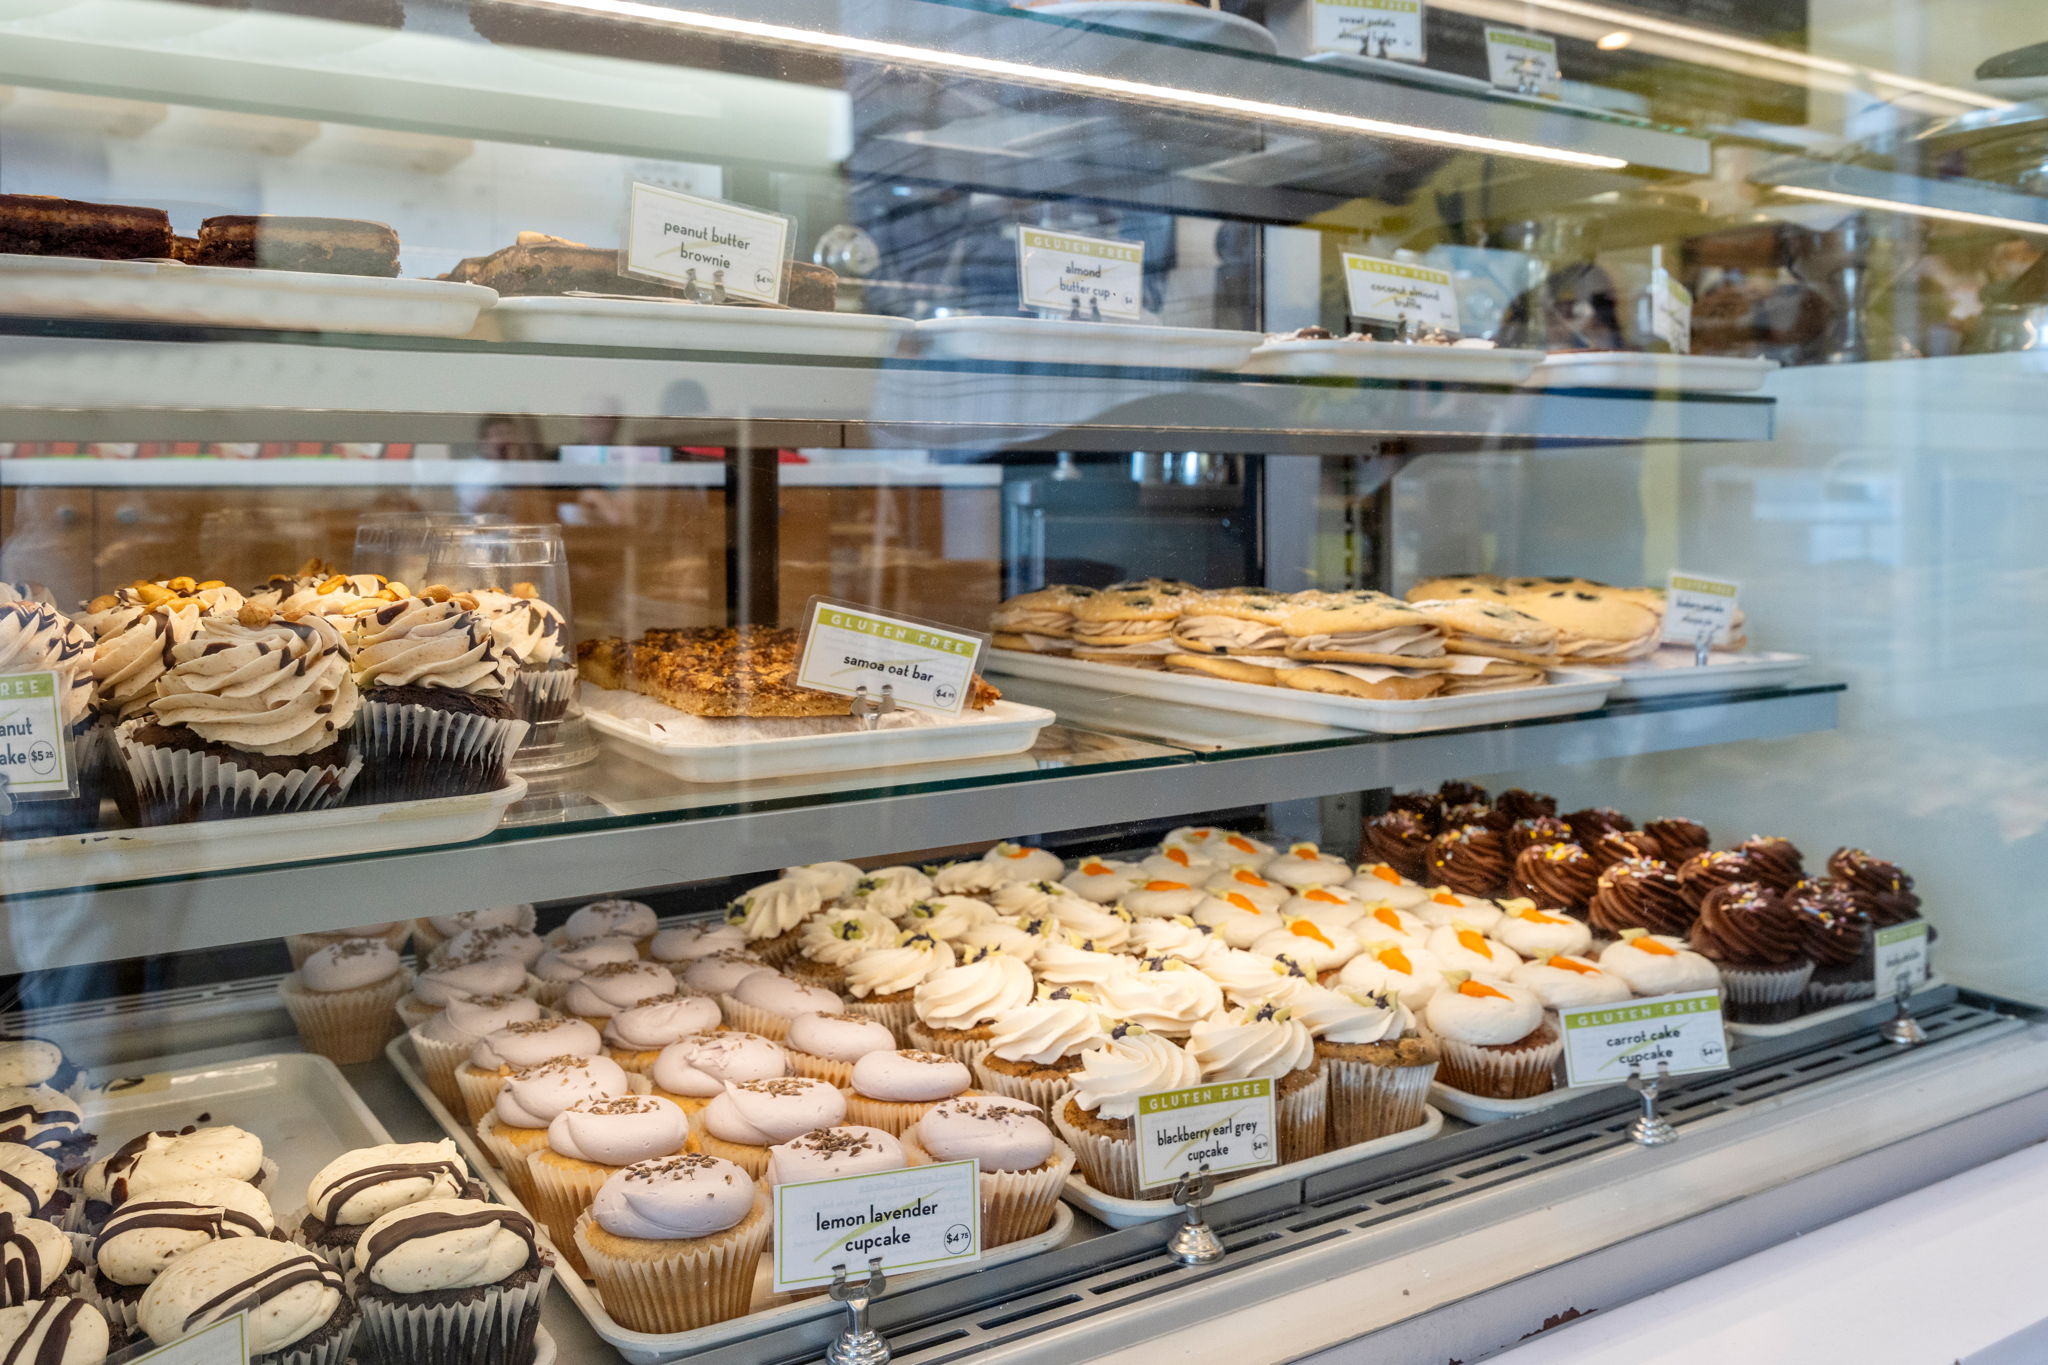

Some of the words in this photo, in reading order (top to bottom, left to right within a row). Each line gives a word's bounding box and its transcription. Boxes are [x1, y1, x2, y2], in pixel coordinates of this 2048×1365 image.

[664, 222, 708, 241] peanut
[711, 226, 751, 250] butter
[1033, 235, 1091, 253] GLUTEN
[1098, 246, 1133, 261] FREE
[680, 242, 731, 269] brownie
[1065, 261, 1102, 278] almond
[1059, 276, 1091, 294] butter
[1093, 288, 1111, 300] cup
[1370, 283, 1406, 296] coconut
[1409, 284, 1440, 301] almond
[831, 614, 907, 640] GLUTEN
[917, 633, 965, 653] FREE
[843, 655, 885, 672] samoa
[888, 665, 909, 678] oat
[912, 664, 934, 682] bar
[1577, 1007, 1651, 1026] GLUTEN
[1663, 999, 1710, 1015] FREE
[1606, 1030, 1646, 1047] carrot
[1650, 1024, 1681, 1042] cake
[1618, 1044, 1674, 1064] cupcake
[1150, 1089, 1212, 1111] GLUTEN
[1222, 1083, 1261, 1102] FREE
[1157, 1124, 1210, 1147] blackberry
[1213, 1117, 1233, 1136] earl
[1235, 1121, 1258, 1138] grey
[1187, 1140, 1229, 1164] cupcake
[816, 1211, 865, 1231] lemon
[870, 1197, 938, 1224] lavender
[845, 1226, 911, 1254] cupcake
